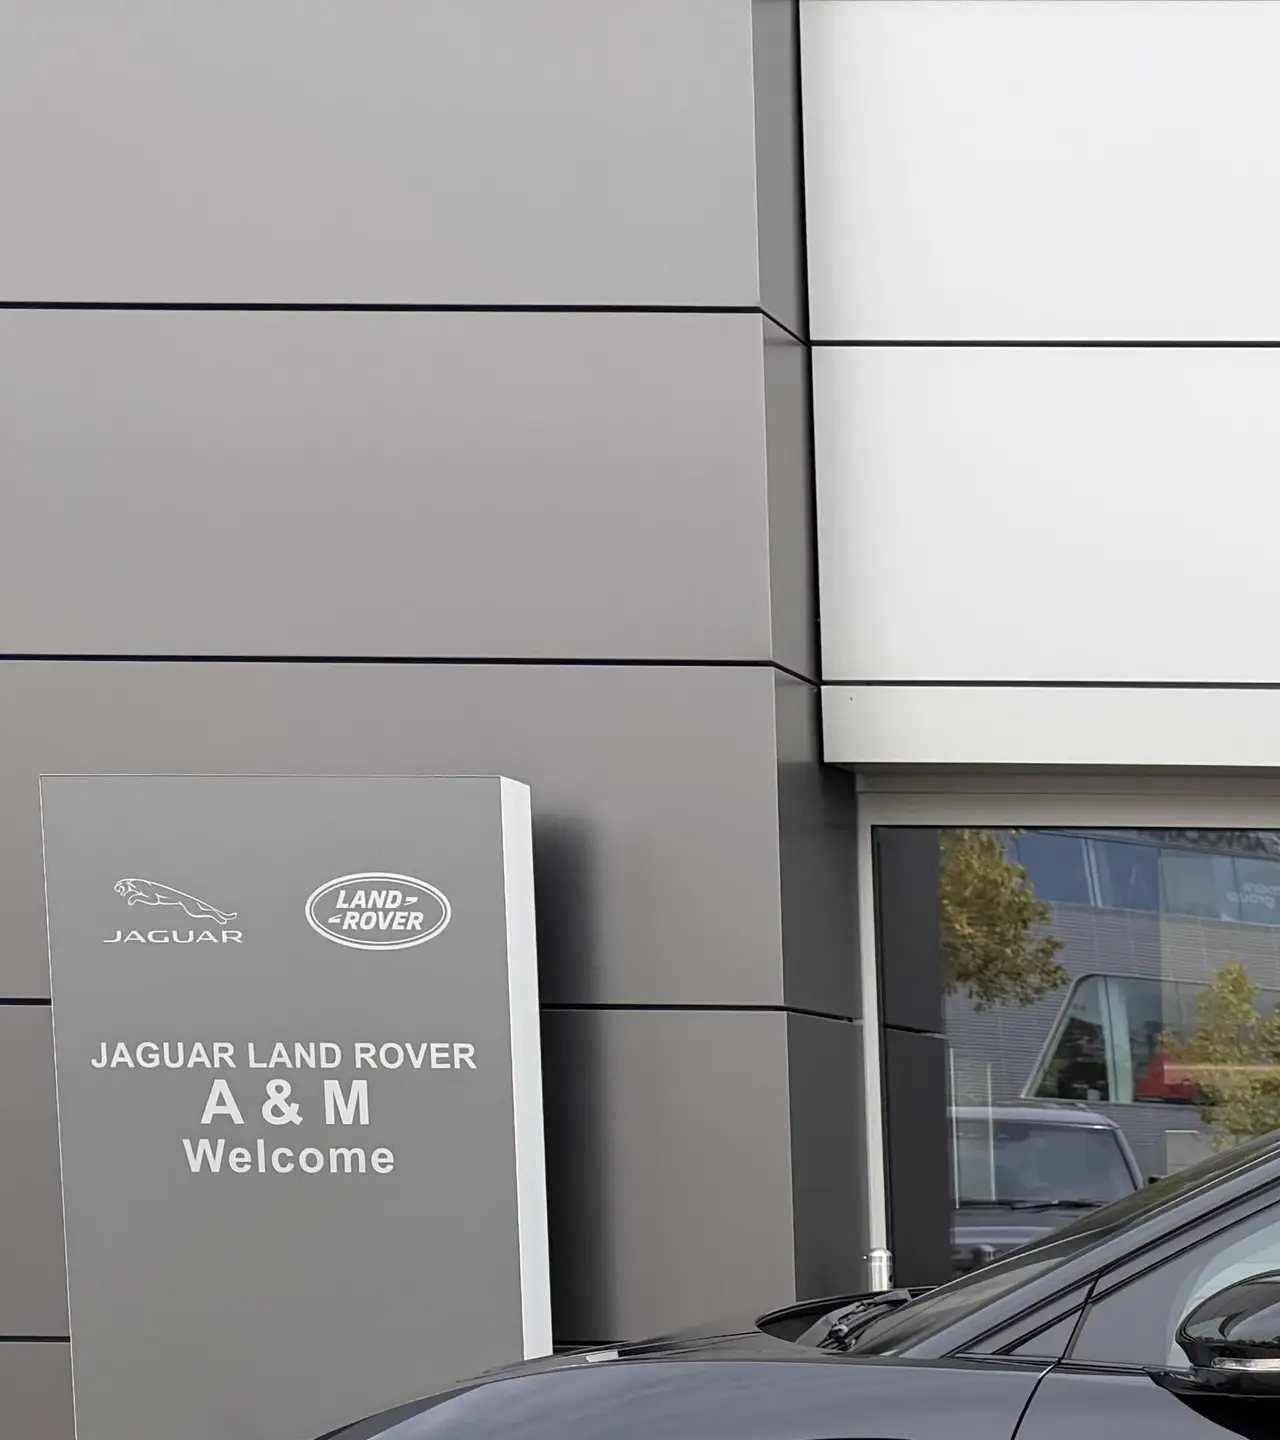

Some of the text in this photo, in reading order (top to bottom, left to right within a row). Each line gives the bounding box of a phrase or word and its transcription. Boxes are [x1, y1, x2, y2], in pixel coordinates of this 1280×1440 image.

[335, 889, 403, 910] LAND
[342, 910, 425, 931] ROVER
[102, 929, 244, 944] JAGUAR
[91, 1041, 477, 1069] JAGUAR LAND ROVER
[200, 1078, 370, 1126] A & M
[182, 1138, 395, 1174] Welcome
